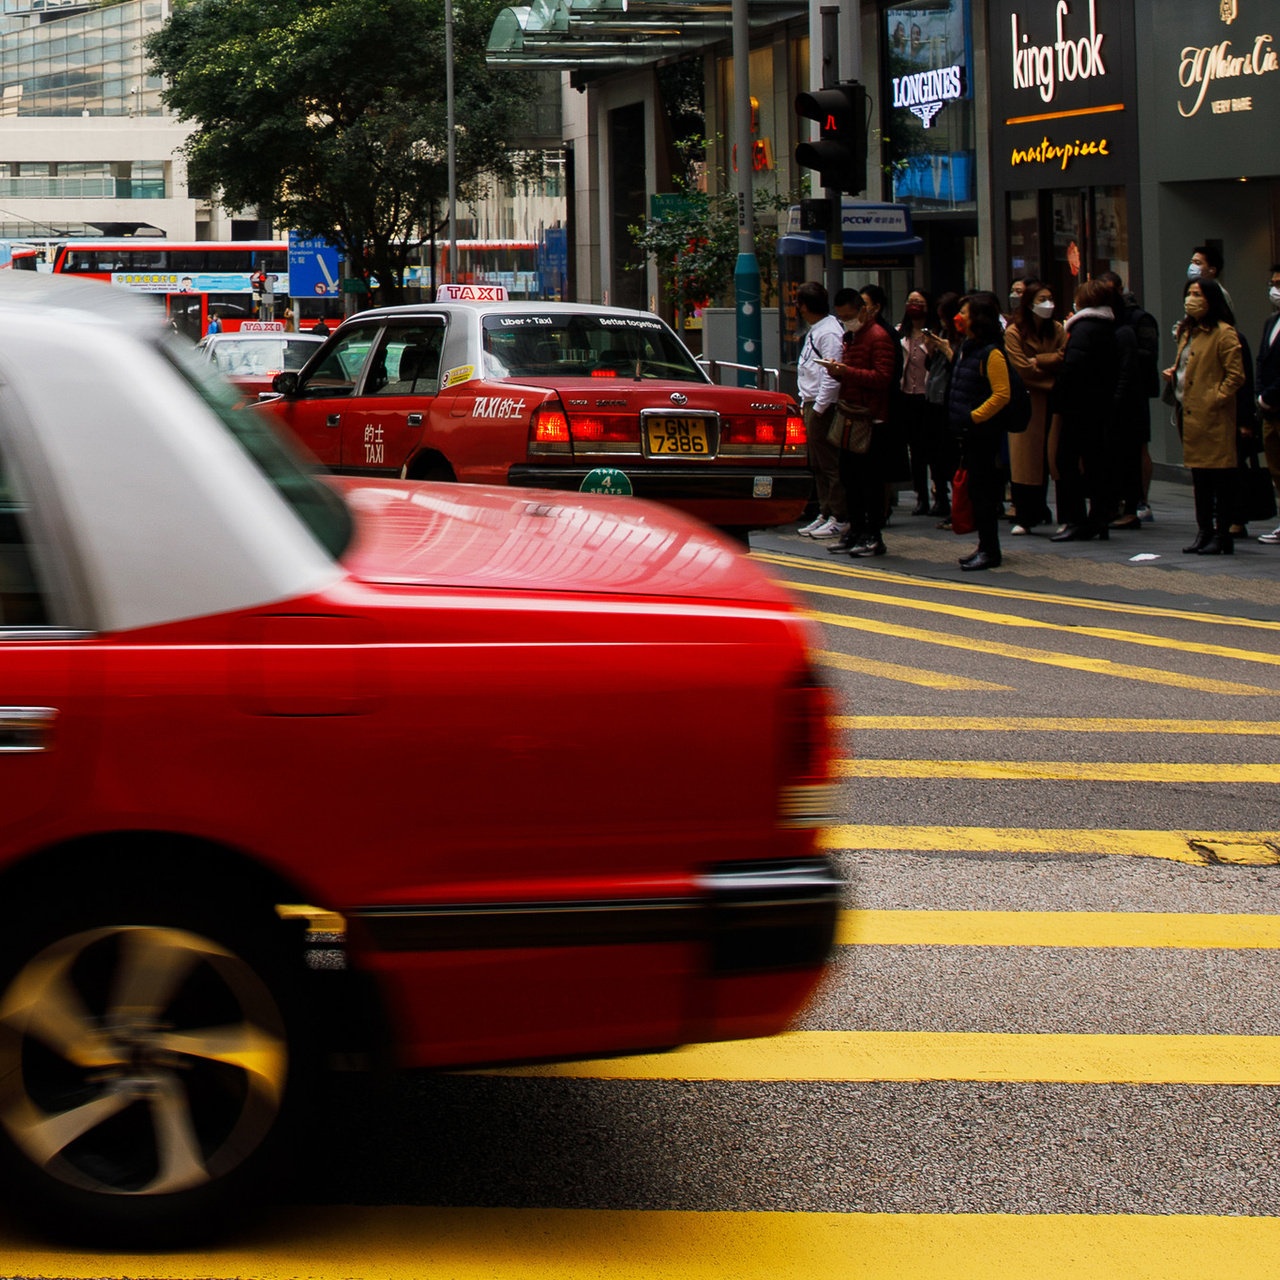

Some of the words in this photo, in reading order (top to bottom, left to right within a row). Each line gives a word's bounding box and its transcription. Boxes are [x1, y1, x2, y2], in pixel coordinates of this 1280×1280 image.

[1012, 13, 1054, 102] king
[893, 66, 961, 108] LONGINES
[1011, 136, 1109, 170] masterpiece
[842, 216, 872, 224] PCCW
[447, 286, 504, 301] TAXI
[244, 322, 282, 332] TAXI
[599, 318, 627, 326] Better
[627, 320, 662, 330] together
[364, 424, 384, 443] 的士
[666, 420, 691, 436] GN
[654, 436, 704, 453] 7386
[364, 444, 384, 463] TAXI
[601, 476, 612, 487] 4
